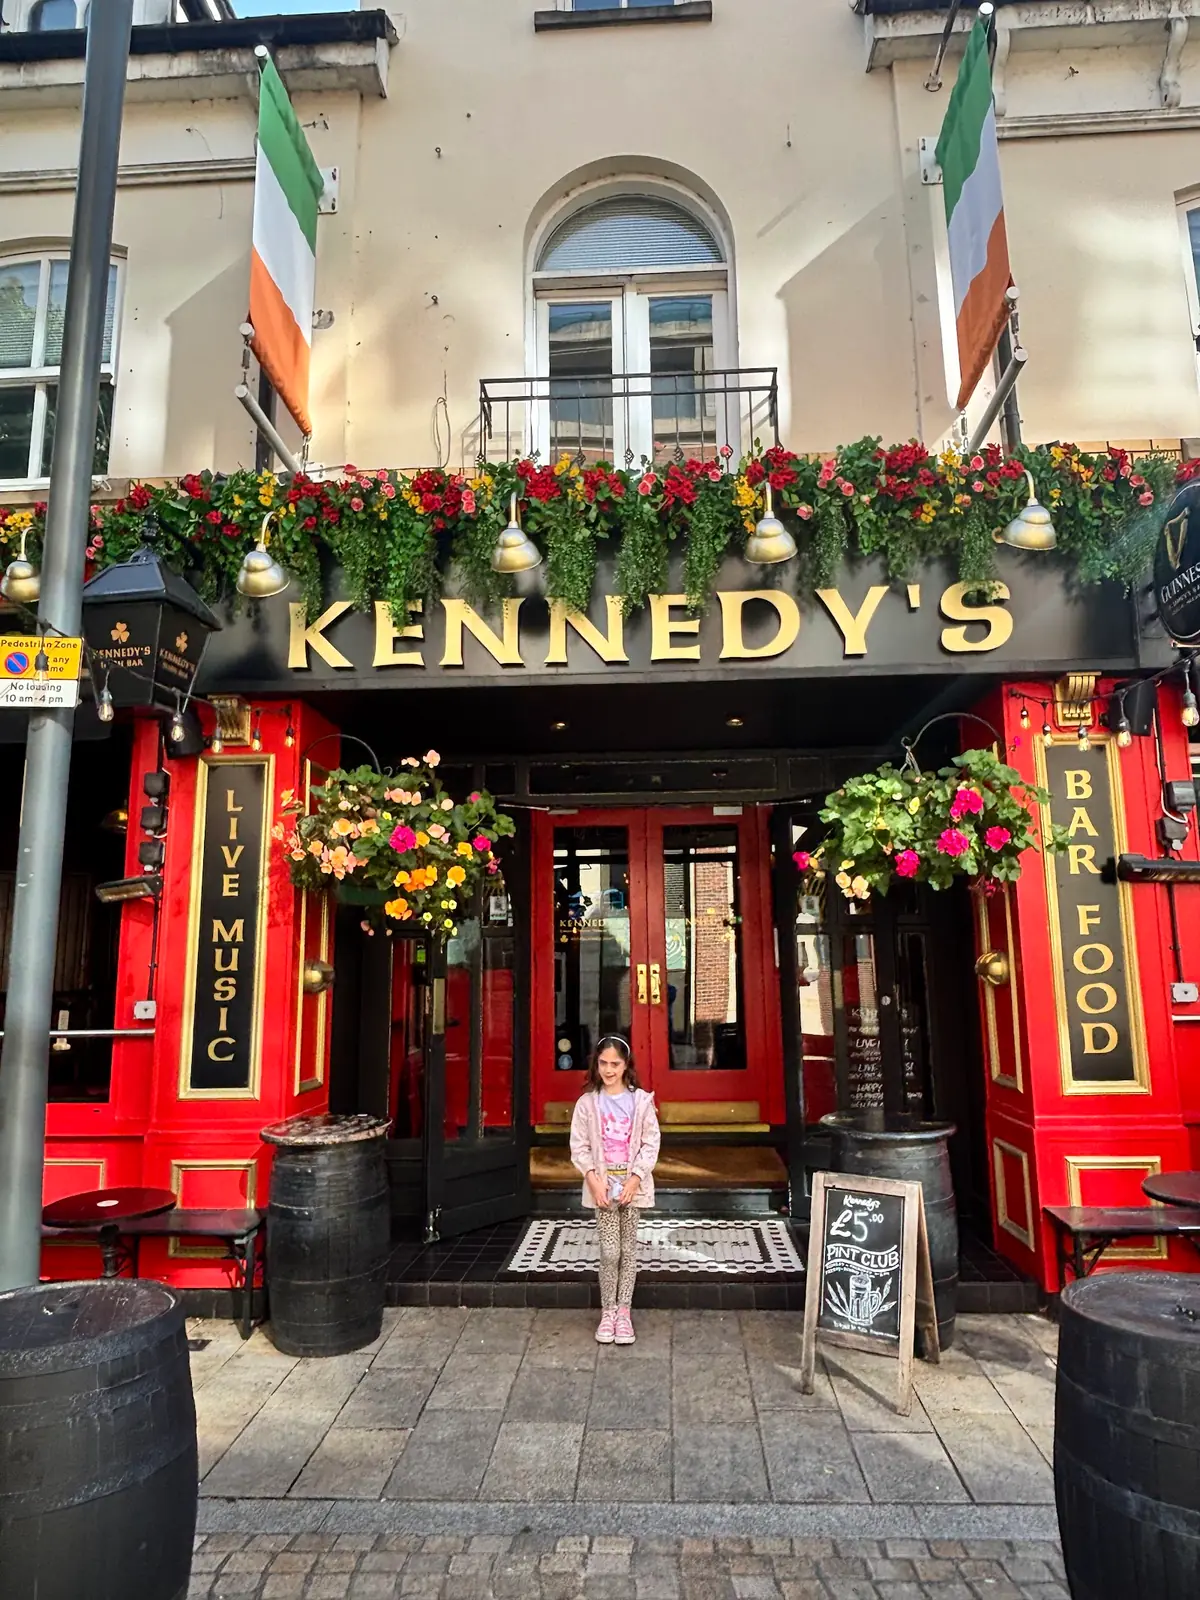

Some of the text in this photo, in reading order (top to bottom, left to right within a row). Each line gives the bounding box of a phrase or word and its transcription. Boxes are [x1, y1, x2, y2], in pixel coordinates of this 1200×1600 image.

[288, 580, 1014, 668] KENNEDY'S
[54, 640, 78, 648] Zone
[53, 656, 70, 664] any
[126, 659, 143, 668] BAR
[10, 682, 24, 691] No
[5, 694, 16, 702] 10
[48, 696, 63, 704] pm
[1065, 769, 1118, 1054] BAR FOOD
[207, 789, 244, 1062] LIVE MUSIC
[827, 1246, 899, 1268] PINT CLUB
